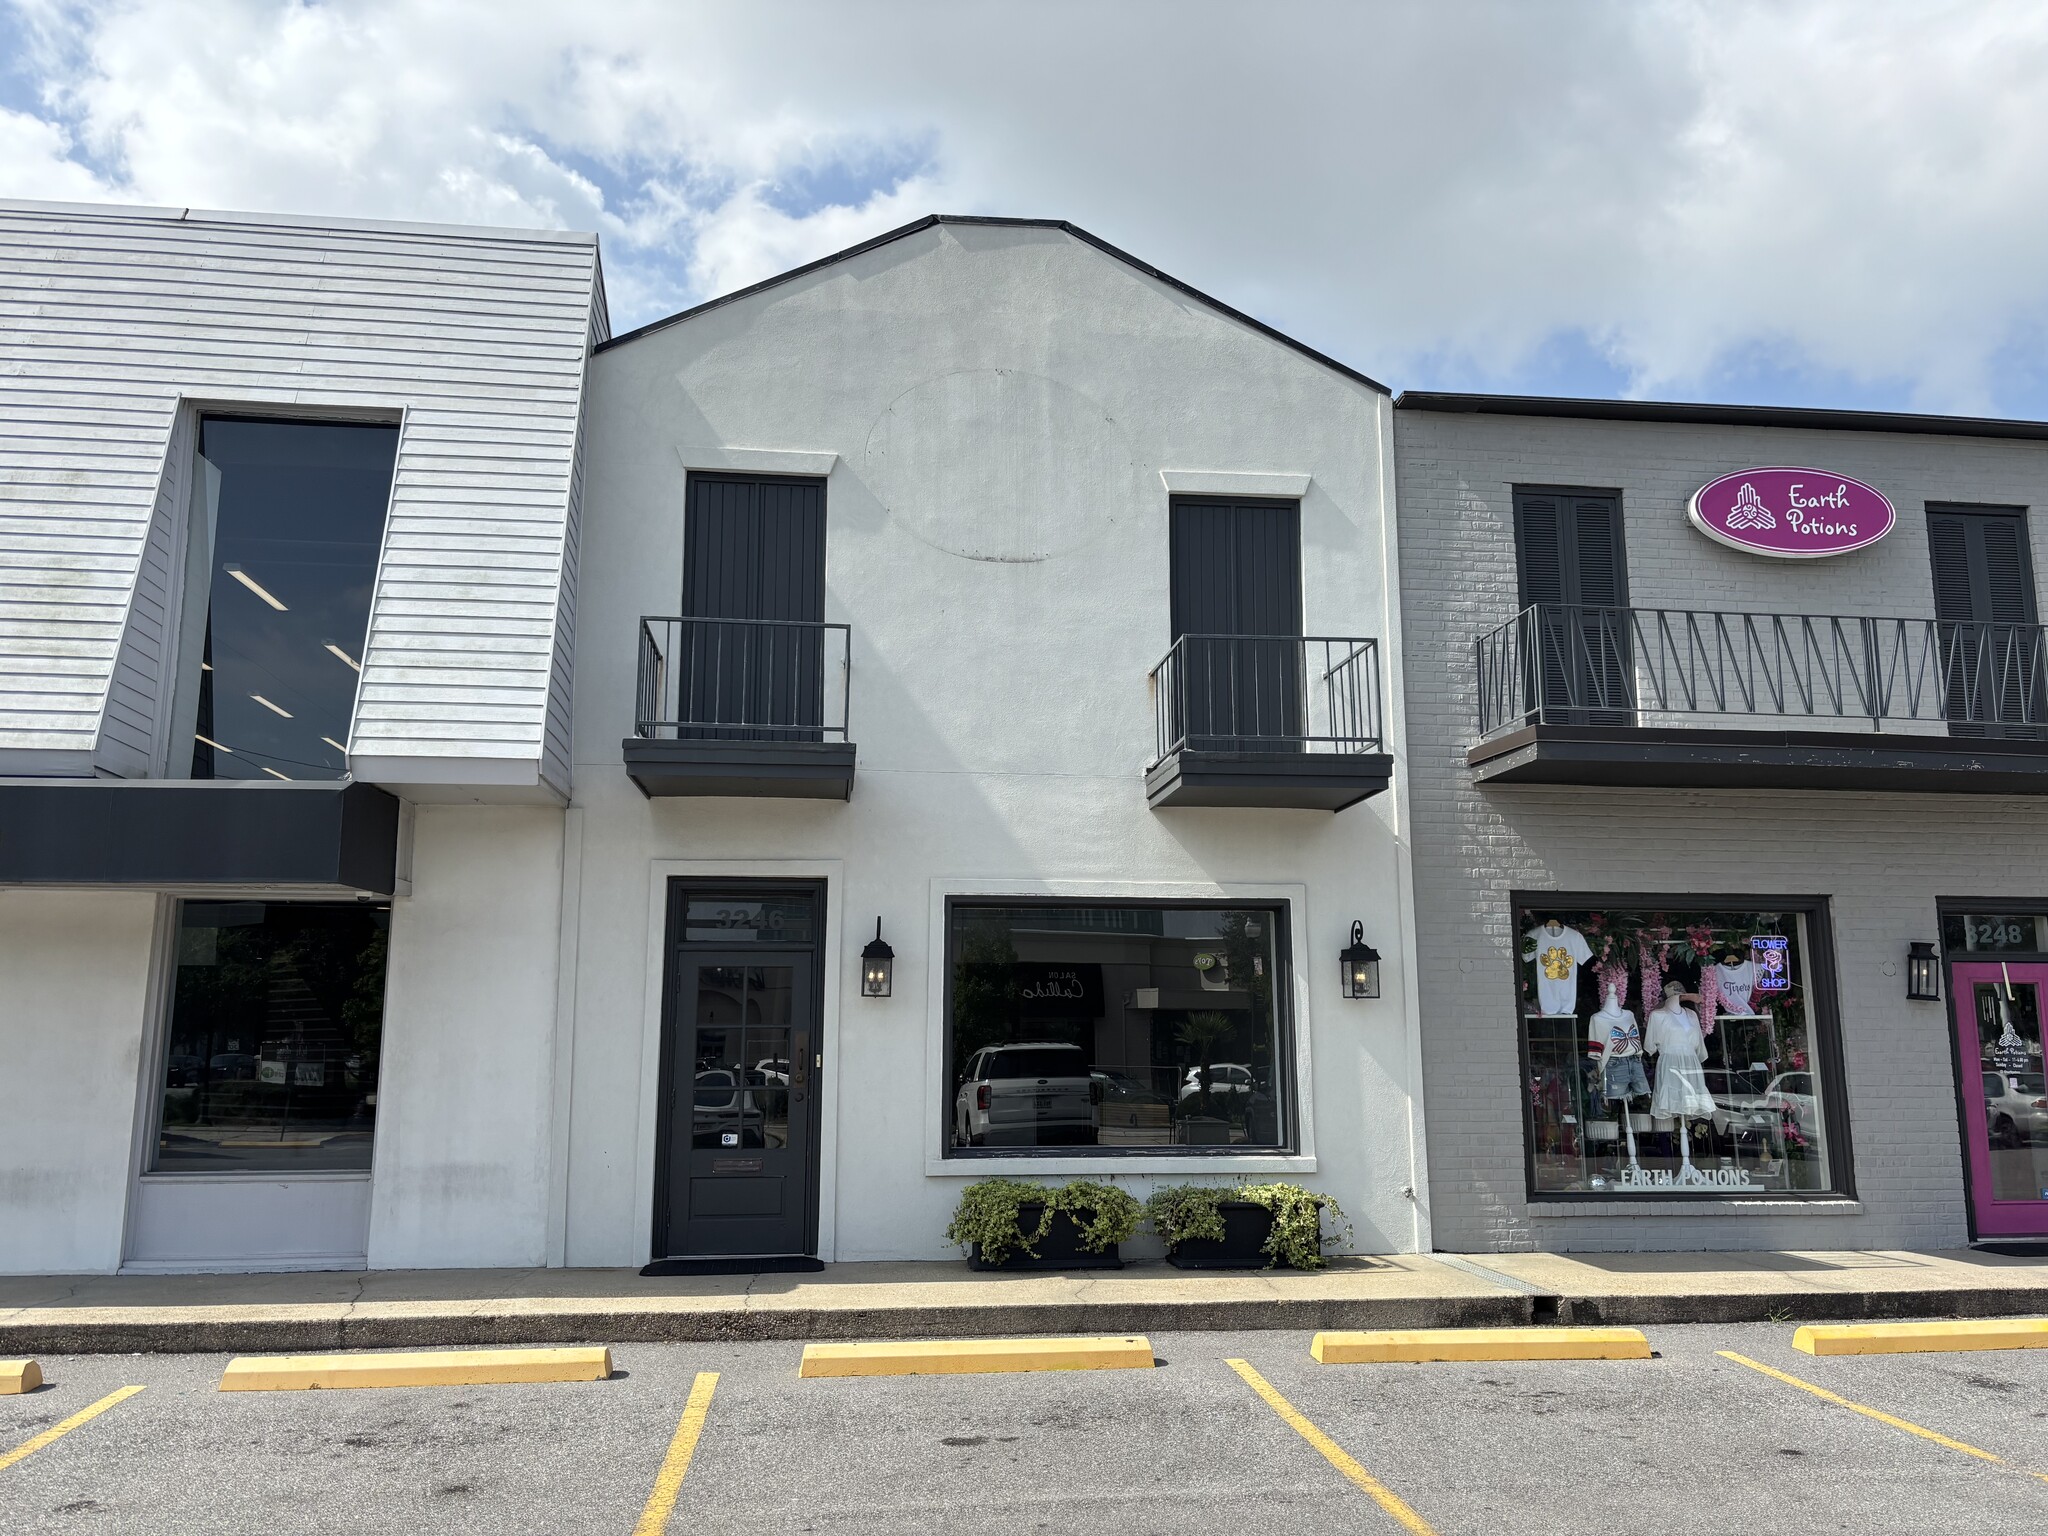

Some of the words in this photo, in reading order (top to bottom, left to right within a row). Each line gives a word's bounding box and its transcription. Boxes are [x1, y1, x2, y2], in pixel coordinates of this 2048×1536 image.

[1788, 484, 1850, 509] Earth
[1786, 508, 1858, 536] Potions
[716, 909, 785, 930] 3246
[1965, 924, 2022, 944] 3248
[1752, 939, 1788, 950] FLOWER
[1762, 978, 1786, 988] SHOP
[1620, 1169, 1673, 1186] EARTH
[1683, 1169, 1750, 1186] POTIONS
